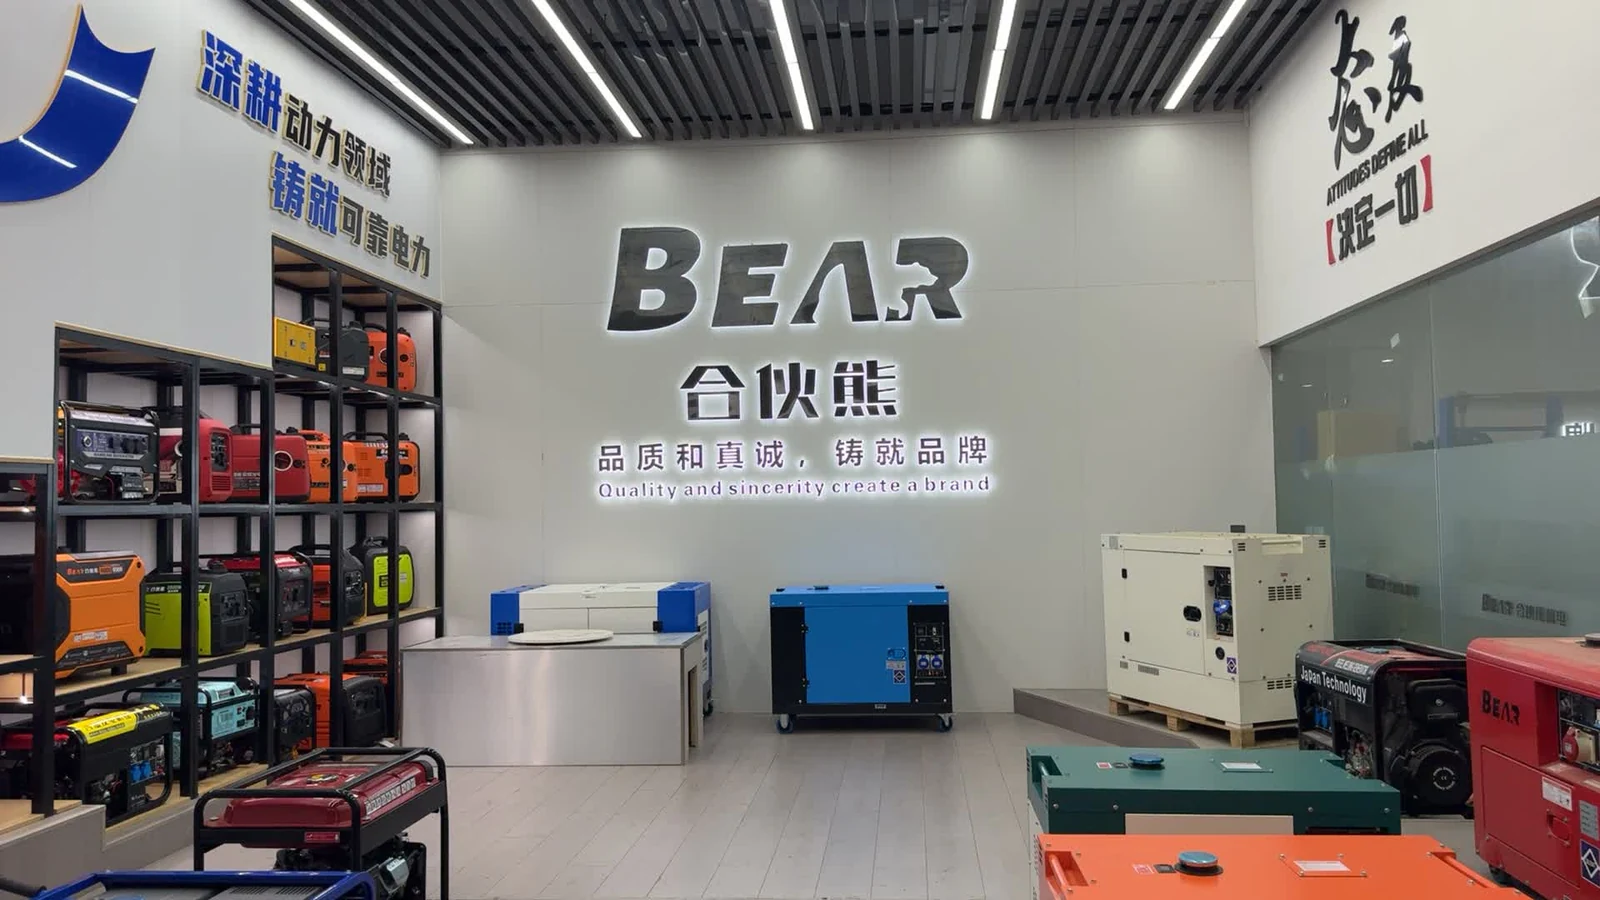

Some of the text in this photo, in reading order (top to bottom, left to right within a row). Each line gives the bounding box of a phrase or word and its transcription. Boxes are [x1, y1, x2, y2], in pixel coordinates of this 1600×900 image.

[197, 29, 391, 198] 深耕动力领域
[1326, 119, 1429, 207] ATTITUDES DEFINE ALL
[270, 149, 431, 279] 铸就可靠电力
[607, 226, 970, 332] BEAR
[679, 359, 900, 421] 合伙熊
[599, 476, 990, 500] Quality and sincerity create a brand
[1301, 665, 1322, 686] Japan
[1321, 671, 1367, 704] Technology
[1482, 689, 1520, 727] BEAR
